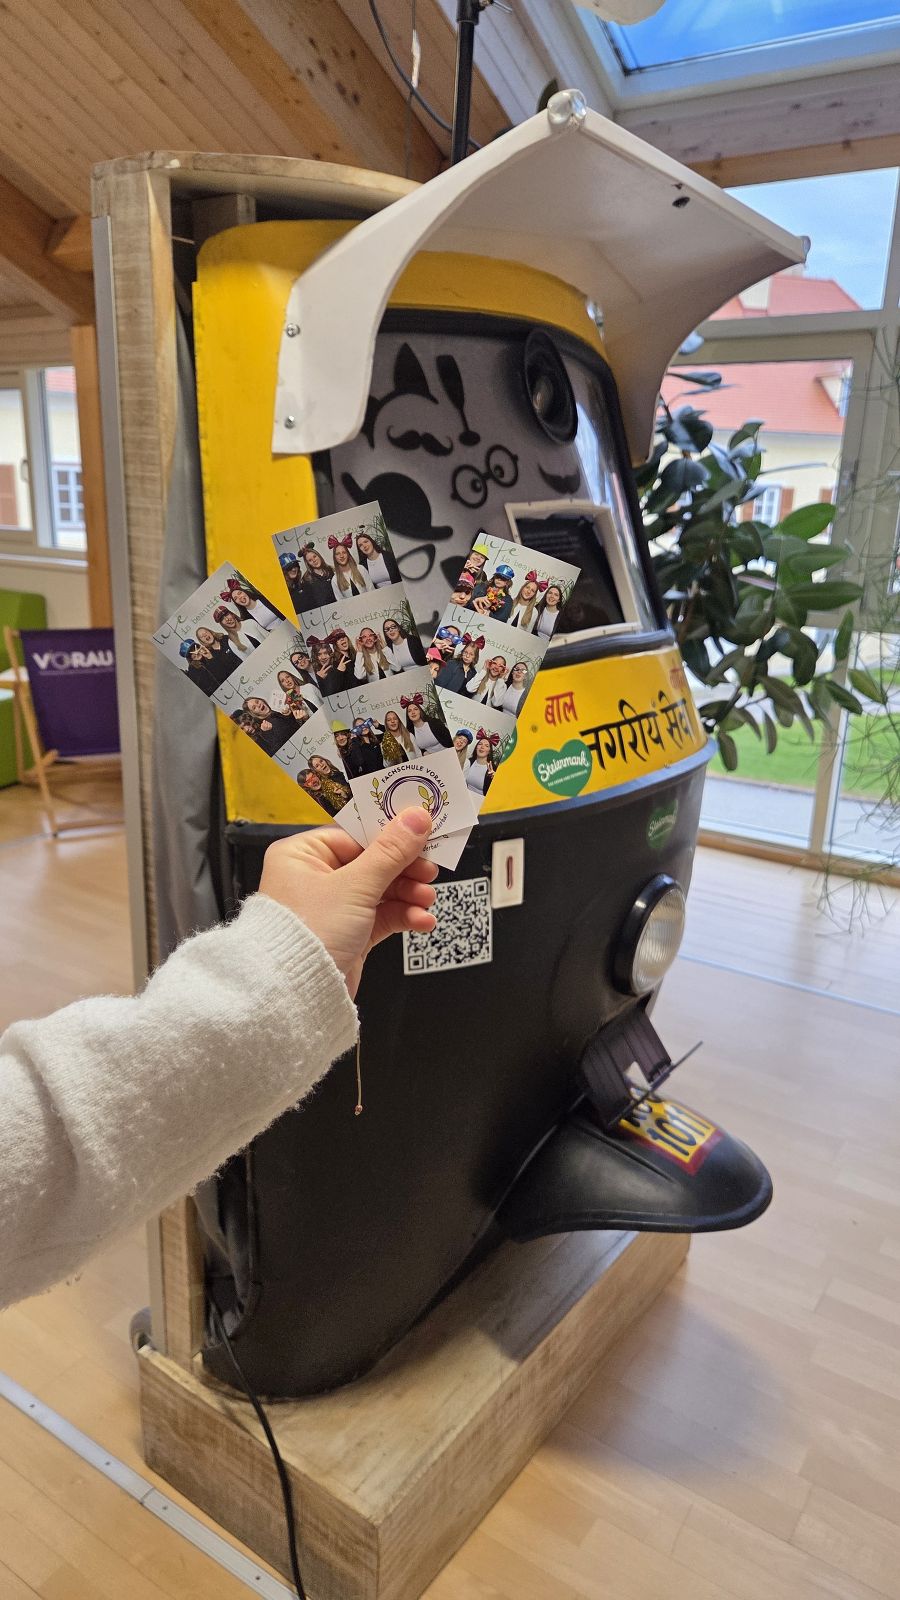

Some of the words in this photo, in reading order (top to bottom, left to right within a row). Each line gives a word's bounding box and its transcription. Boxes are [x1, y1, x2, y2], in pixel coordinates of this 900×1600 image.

[301, 607, 342, 637] life
[452, 605, 487, 633] life
[33, 650, 114, 670] VORAU
[213, 676, 250, 706] life
[327, 689, 368, 720] life
[545, 691, 578, 727] बाल
[274, 736, 313, 766] life
[538, 750, 589, 782] Steiermark
[381, 764, 423, 784] FACHSCHULE
[426, 768, 446, 788] VORAU
[647, 1104, 711, 1157] 1011
